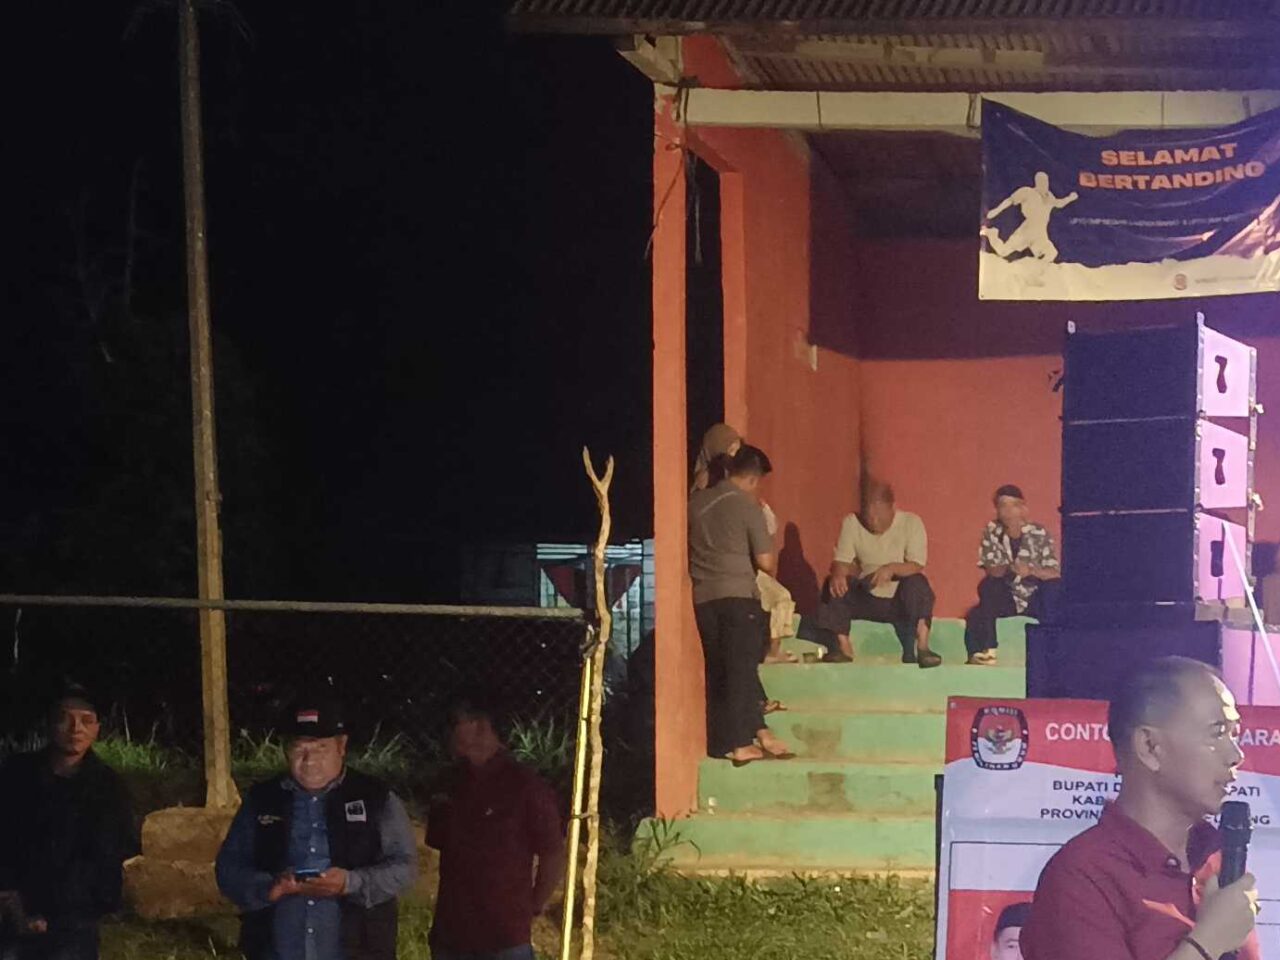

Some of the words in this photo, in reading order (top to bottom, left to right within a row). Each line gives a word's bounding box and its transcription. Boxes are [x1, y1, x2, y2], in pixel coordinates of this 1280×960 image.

[1100, 143, 1238, 166] SELAMAT
[1078, 160, 1266, 190] BERTANDING
[1052, 779, 1109, 792] BUPATI
